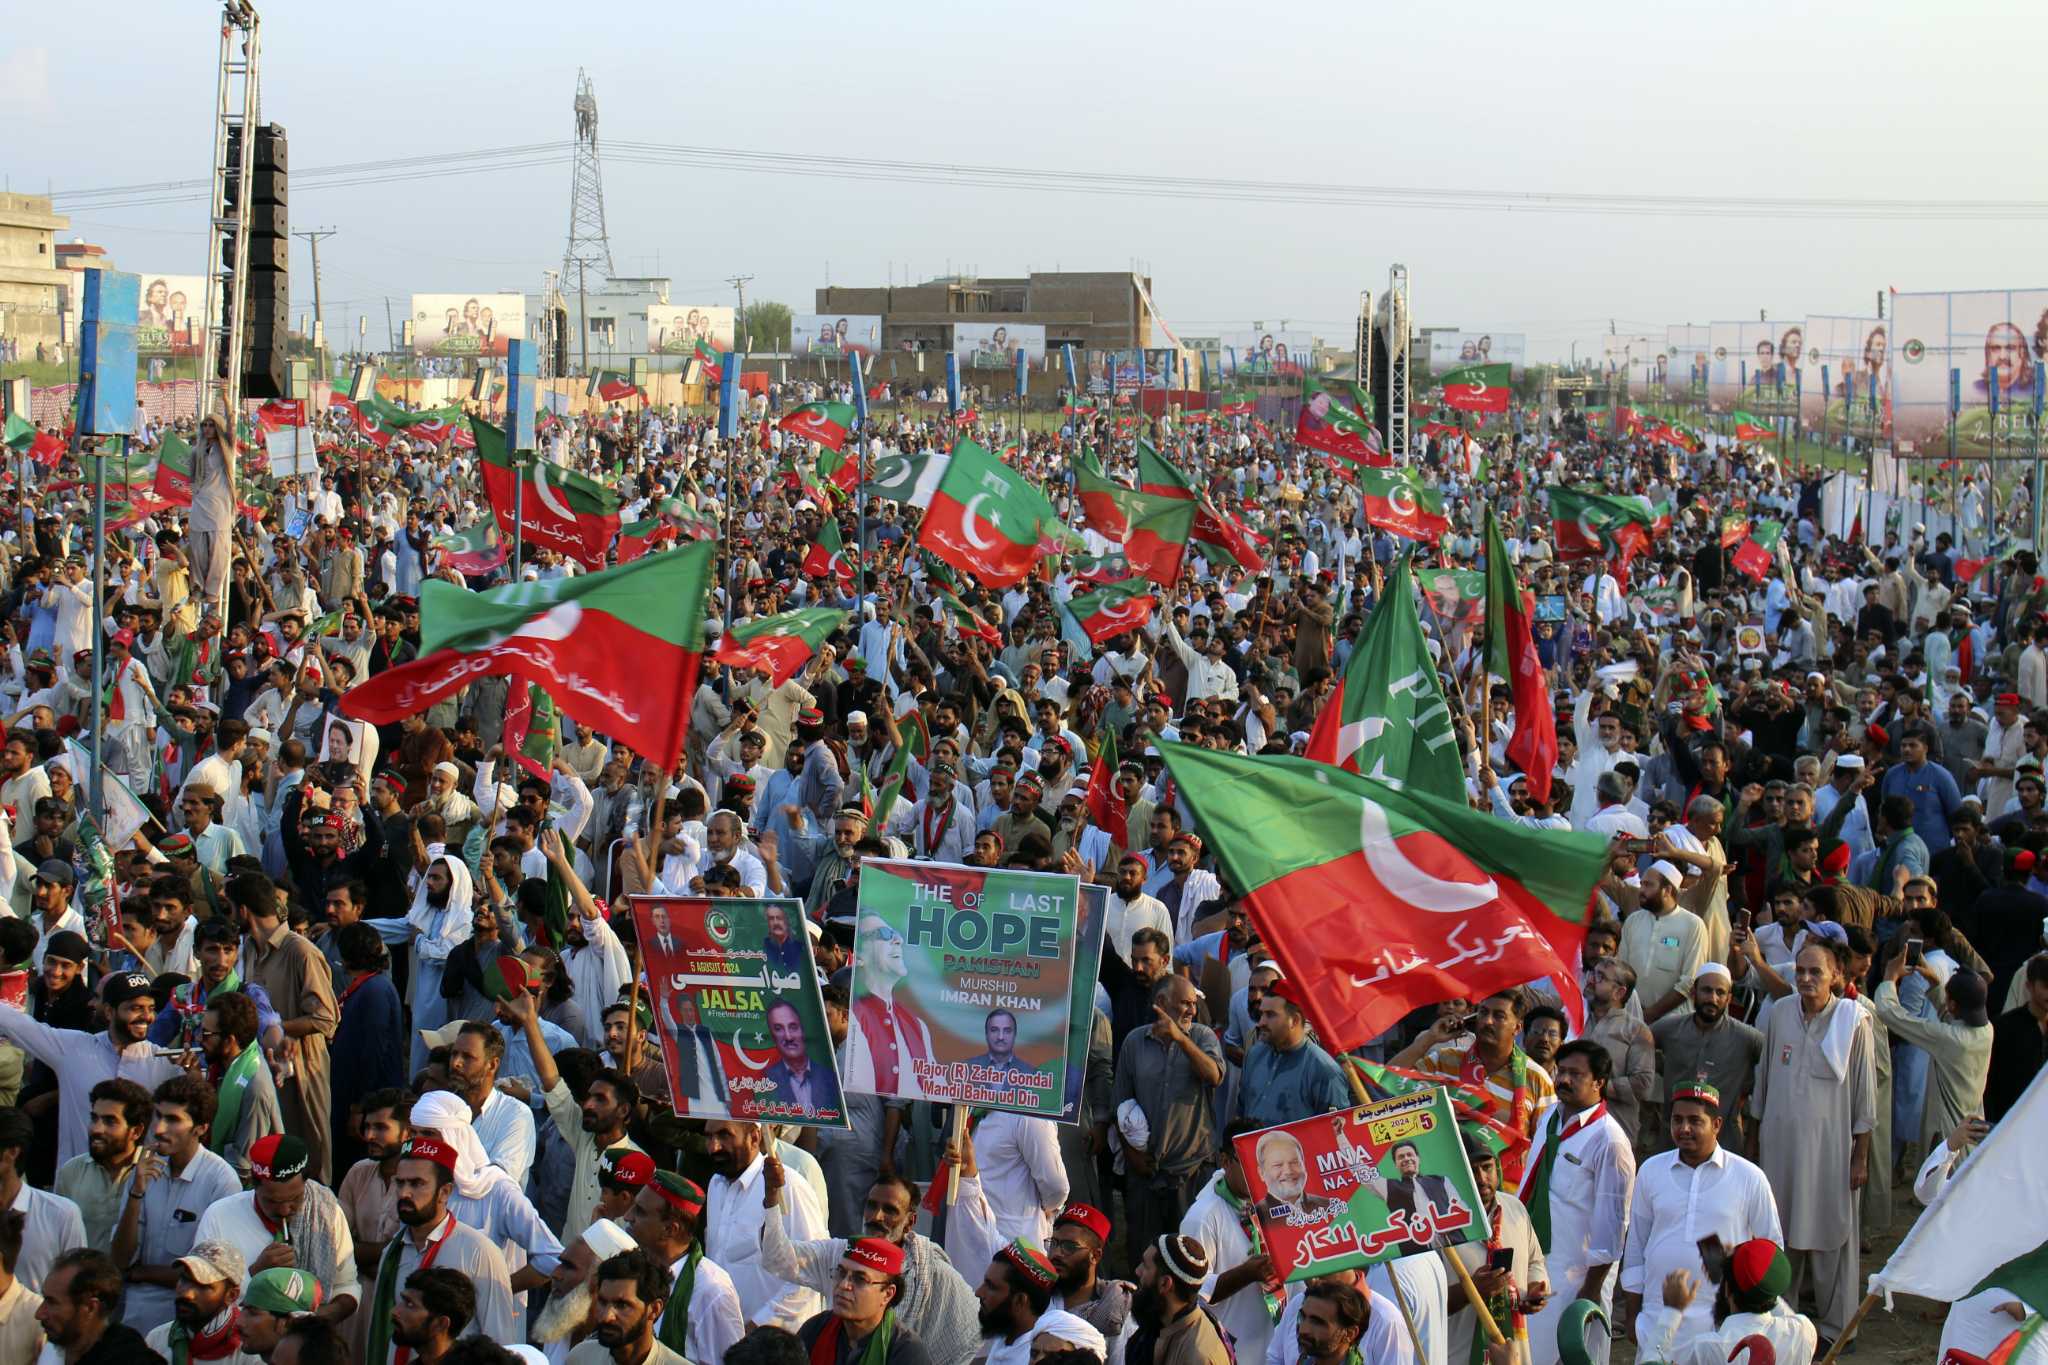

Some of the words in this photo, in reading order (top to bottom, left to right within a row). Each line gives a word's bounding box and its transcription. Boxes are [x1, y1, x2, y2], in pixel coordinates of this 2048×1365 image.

[911, 883, 953, 903] THE
[962, 891, 985, 909] OF
[1009, 892, 1065, 914] LAST
[906, 904, 1061, 959] HOPE
[671, 964, 801, 995] صوابی
[943, 953, 1041, 979] PAKISTAN
[128, 977, 151, 989] 804
[960, 976, 1018, 993] MURSHID
[701, 988, 766, 1012] JALSA
[940, 989, 993, 1007] IMRAN
[996, 994, 1042, 1011] KHAN
[912, 1057, 950, 1079] Major
[949, 1061, 970, 1083] (R)
[971, 1064, 1007, 1083] Zafar
[1007, 1066, 1053, 1090] Gondal
[922, 1079, 963, 1098] Mandi
[962, 1083, 998, 1103] Bahu
[996, 1086, 1016, 1104] ud
[1017, 1088, 1040, 1107] Din
[1391, 1117, 1410, 1128] 2024
[1419, 1112, 1433, 1130] 5
[1384, 1132, 1392, 1141] 4
[1315, 1144, 1373, 1174] MNA
[1323, 1166, 1380, 1192] NA-133
[1360, 1209, 1411, 1255] کی
[1409, 1198, 1472, 1245] خان
[1292, 1221, 1360, 1268] للکار
